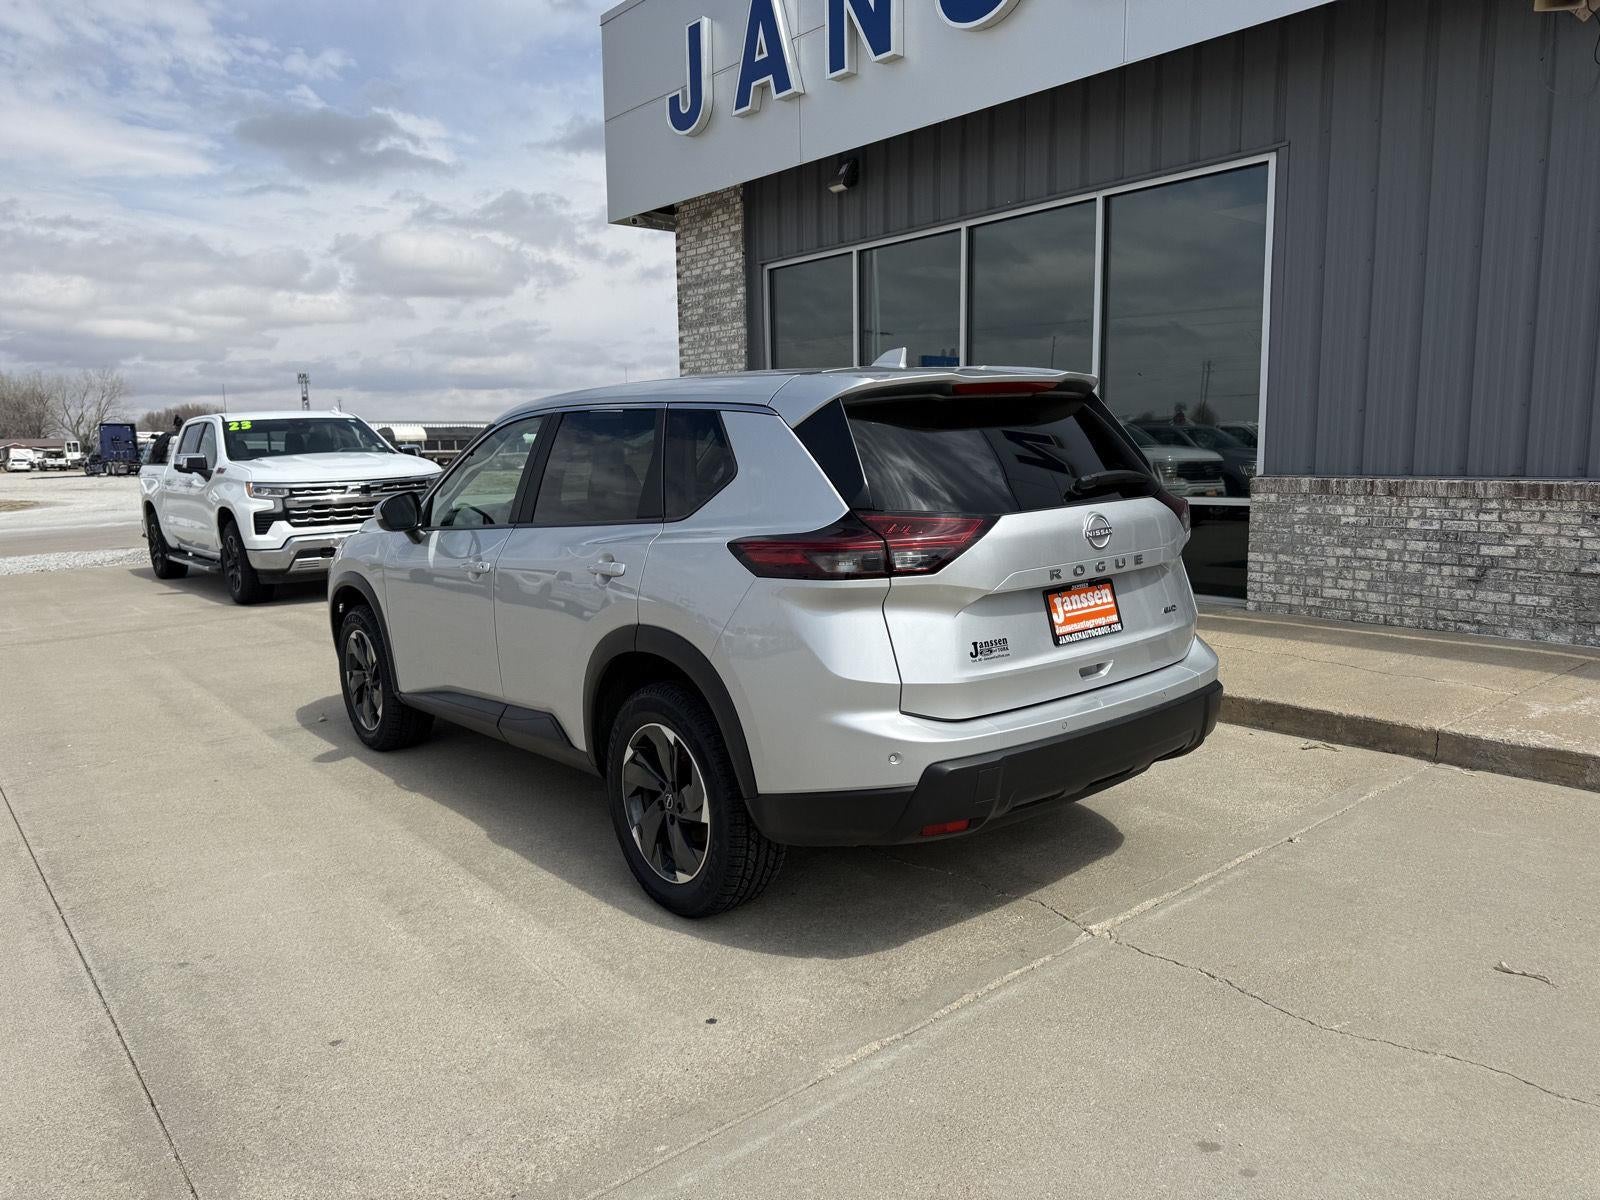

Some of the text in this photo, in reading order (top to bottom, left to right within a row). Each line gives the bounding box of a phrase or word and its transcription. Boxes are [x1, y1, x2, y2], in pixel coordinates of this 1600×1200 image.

[666, 0, 1021, 137] JAN
[228, 421, 252, 431] 23
[1086, 527, 1113, 538] NISSAN
[1049, 554, 1144, 581] ROGUE
[970, 637, 1008, 658] Janssen
